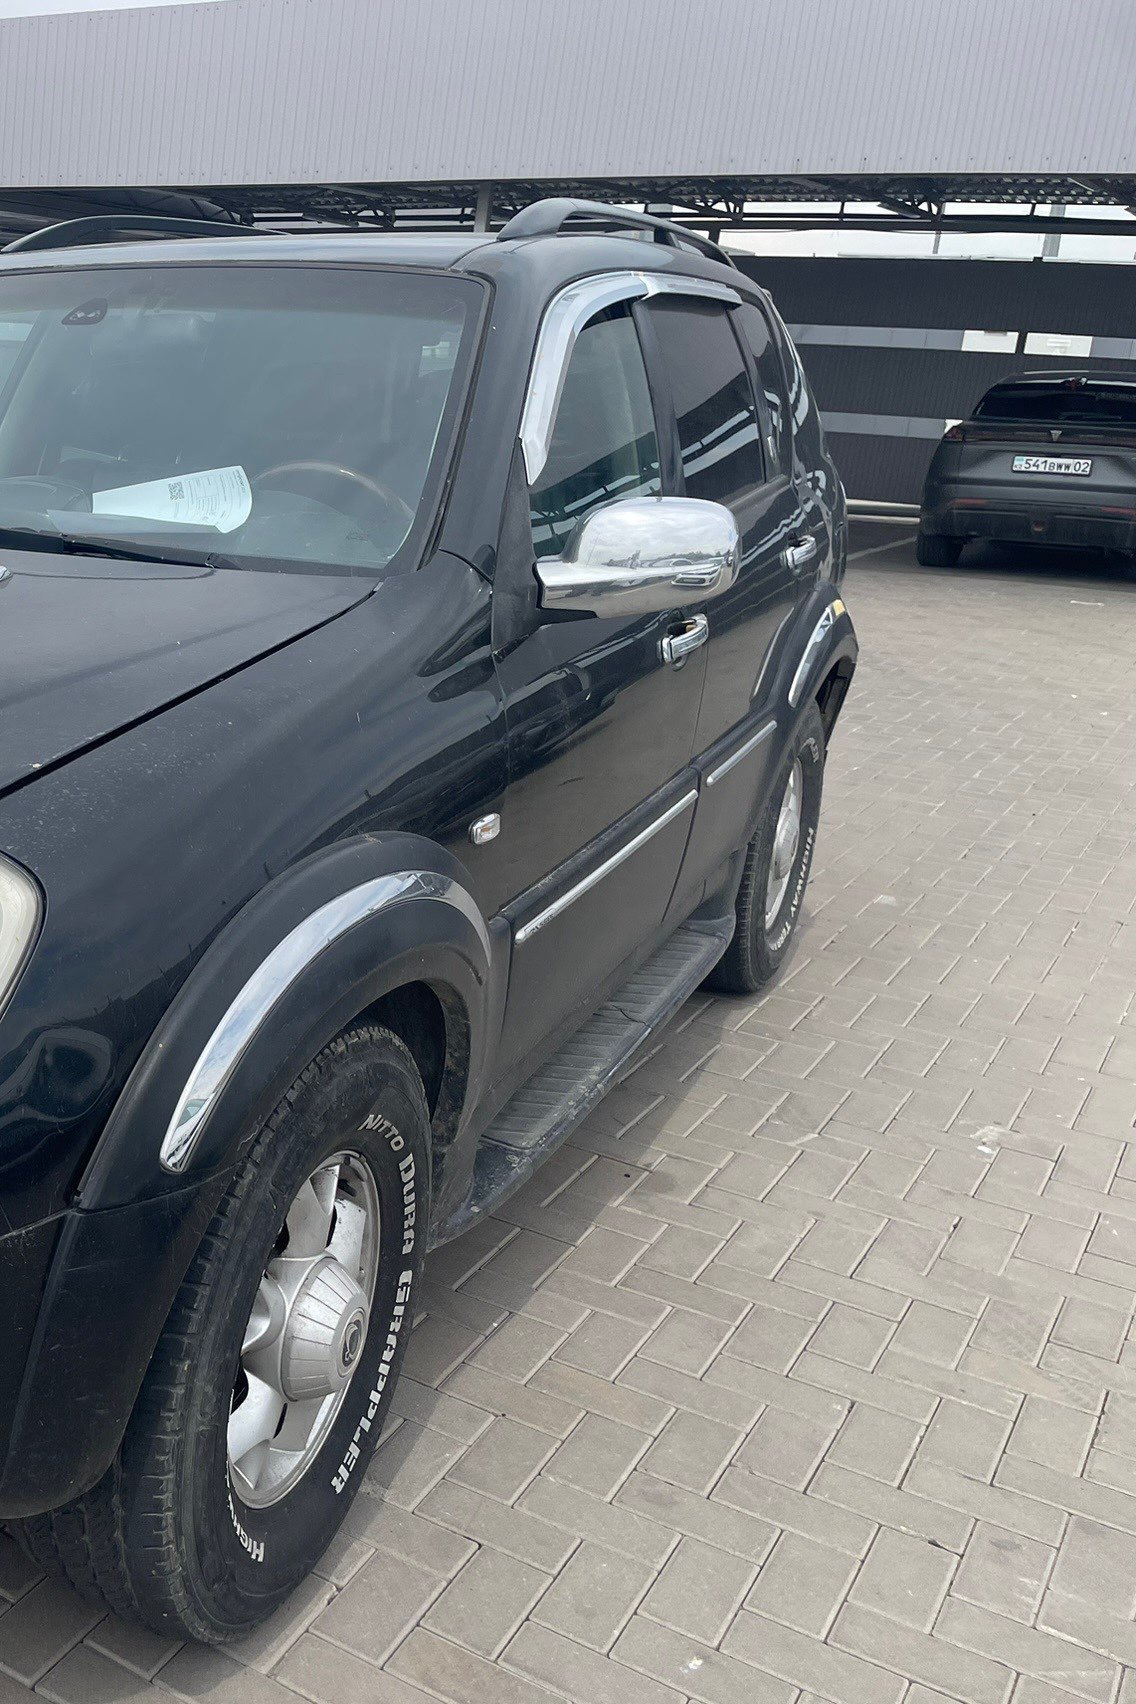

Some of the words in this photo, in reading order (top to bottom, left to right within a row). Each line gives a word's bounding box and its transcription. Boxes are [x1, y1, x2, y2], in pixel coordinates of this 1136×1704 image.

[357, 1114, 405, 1152] NITTO
[398, 1152, 416, 1255] DURA
[330, 1269, 413, 1495] GRAPPLER
